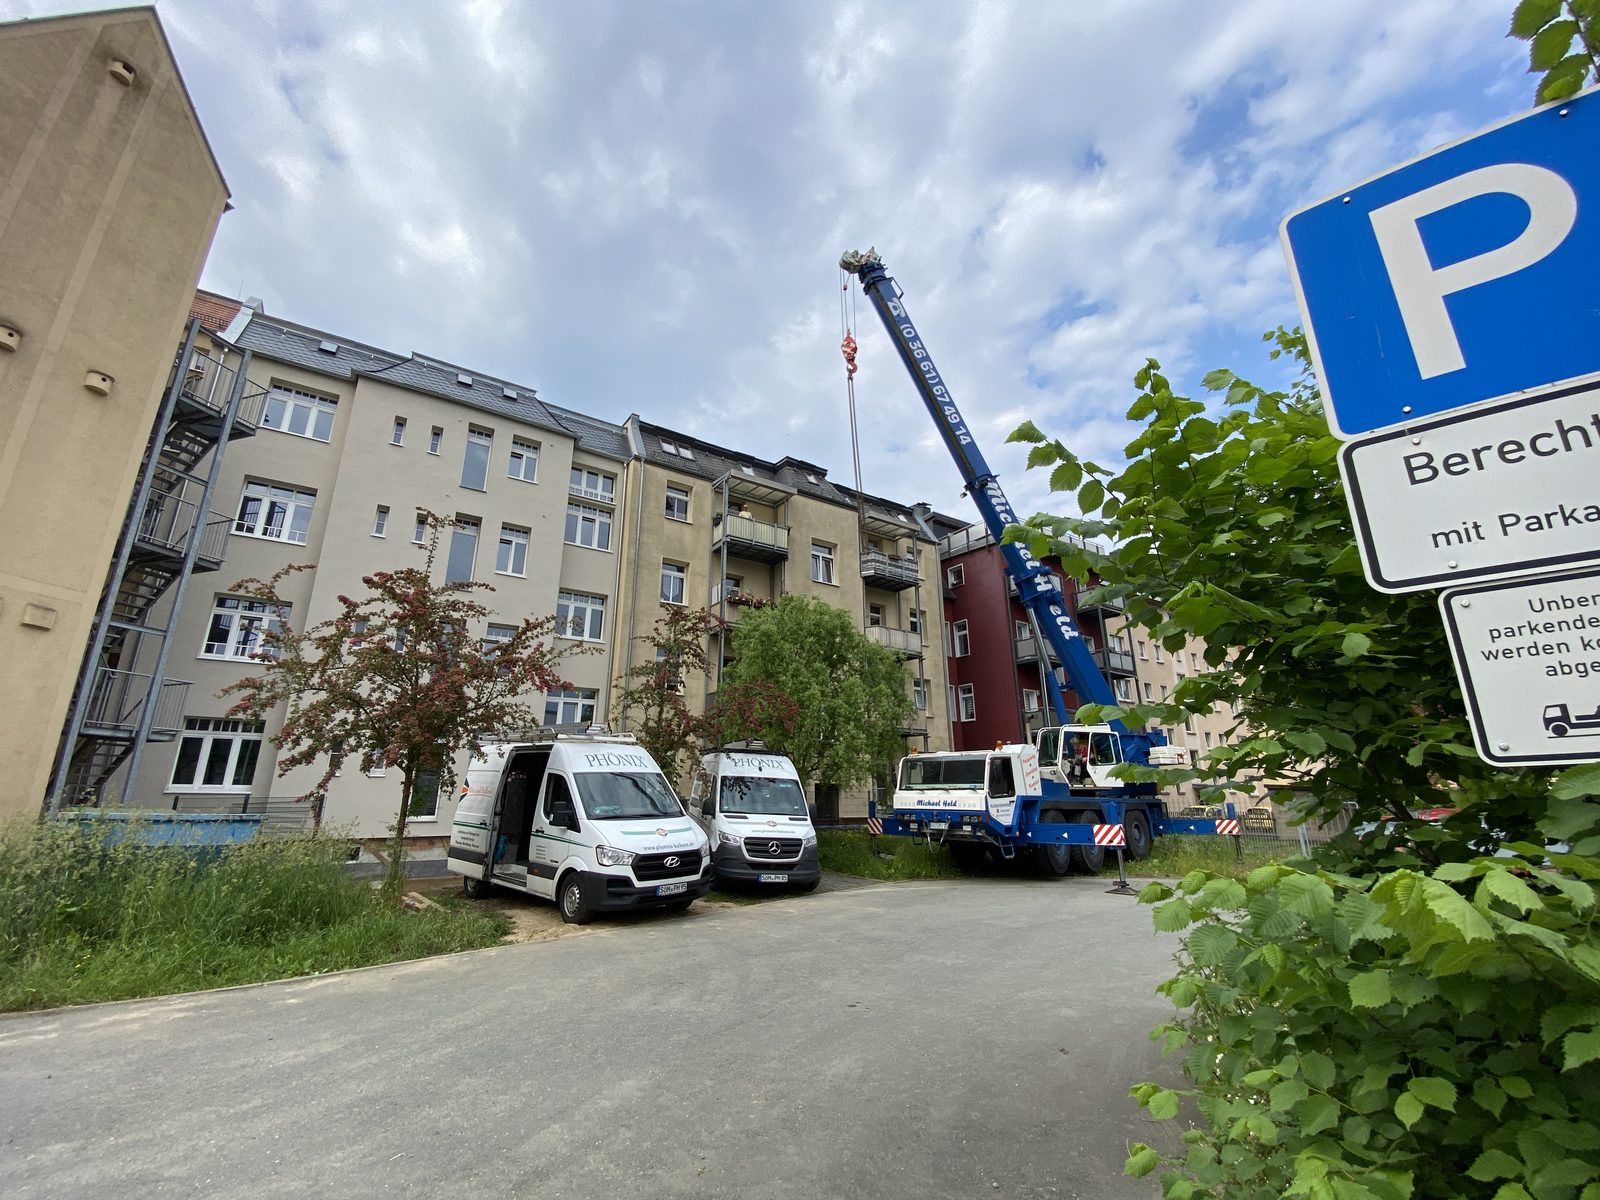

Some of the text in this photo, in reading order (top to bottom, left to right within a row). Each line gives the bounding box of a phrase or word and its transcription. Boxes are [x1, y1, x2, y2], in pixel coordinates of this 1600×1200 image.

[1368, 163, 1577, 380] P
[909, 340, 926, 359] 36
[933, 385, 950, 402] 67
[944, 406, 960, 424] 49
[955, 426, 972, 445] 14
[1431, 504, 1600, 548] mit Parka
[1527, 594, 1600, 613] Unber
[1489, 614, 1600, 643] parkende
[1481, 641, 1571, 661] werden
[1545, 660, 1600, 678] abge
[584, 751, 649, 768] PHÖNIX
